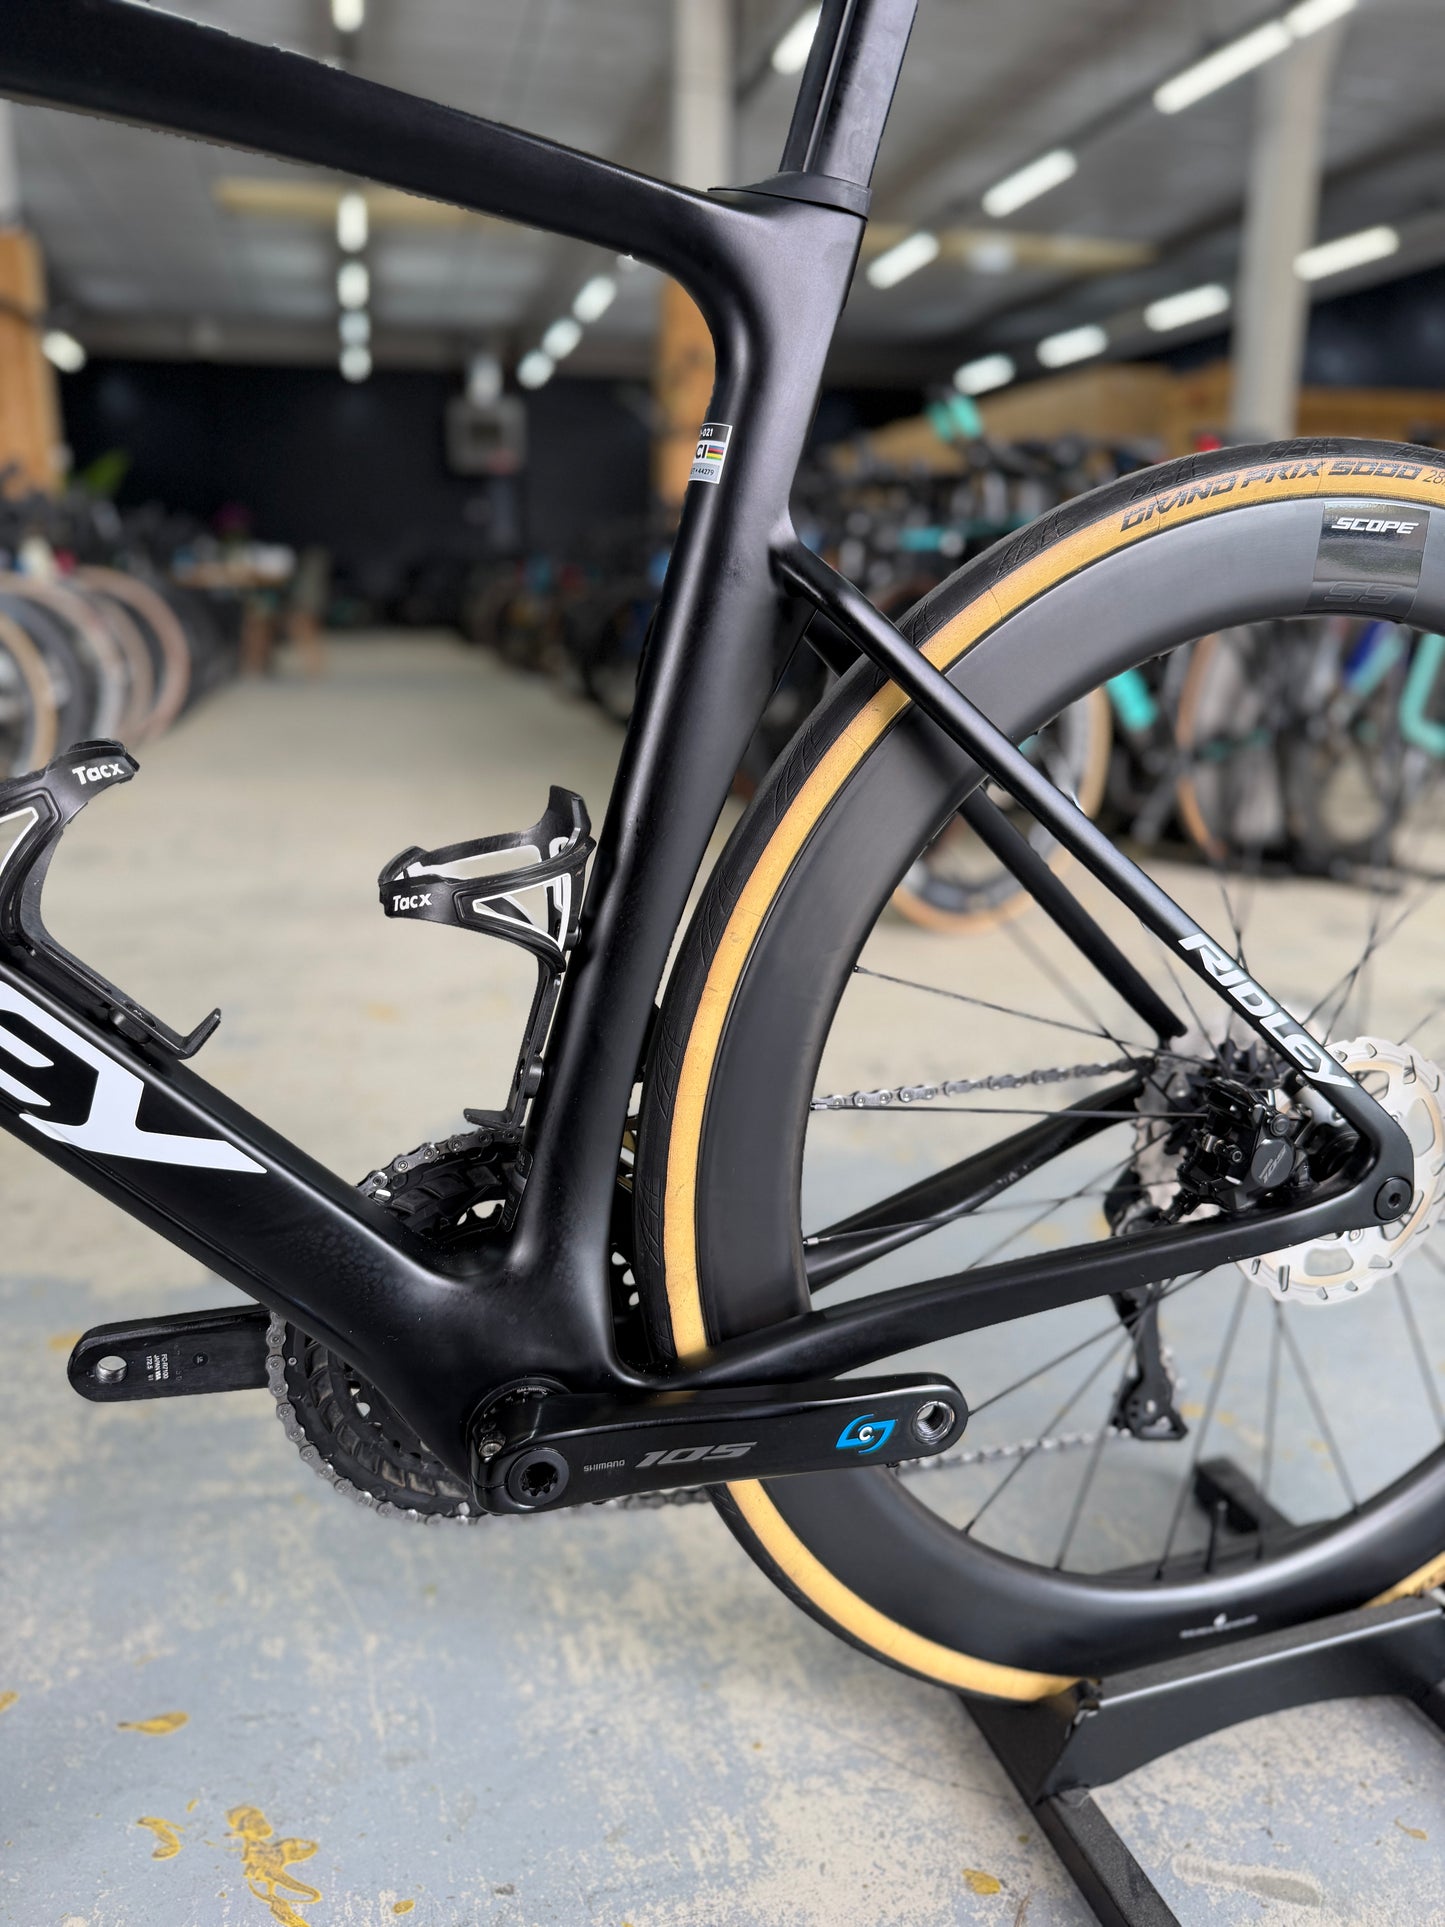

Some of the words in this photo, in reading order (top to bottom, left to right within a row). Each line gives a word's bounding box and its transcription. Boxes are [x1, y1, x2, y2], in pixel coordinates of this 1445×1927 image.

[1120, 475, 1237, 533] GRAND
[1240, 461, 1322, 489] PRIX
[1327, 460, 1423, 481] 5000
[1331, 516, 1420, 535] SCOPE
[71, 763, 125, 785] Tacx
[392, 892, 433, 912] Tacx
[1178, 933, 1356, 1088] RIDLEY
[583, 1459, 626, 1472] SHIMANO
[635, 1441, 758, 1468] 105
